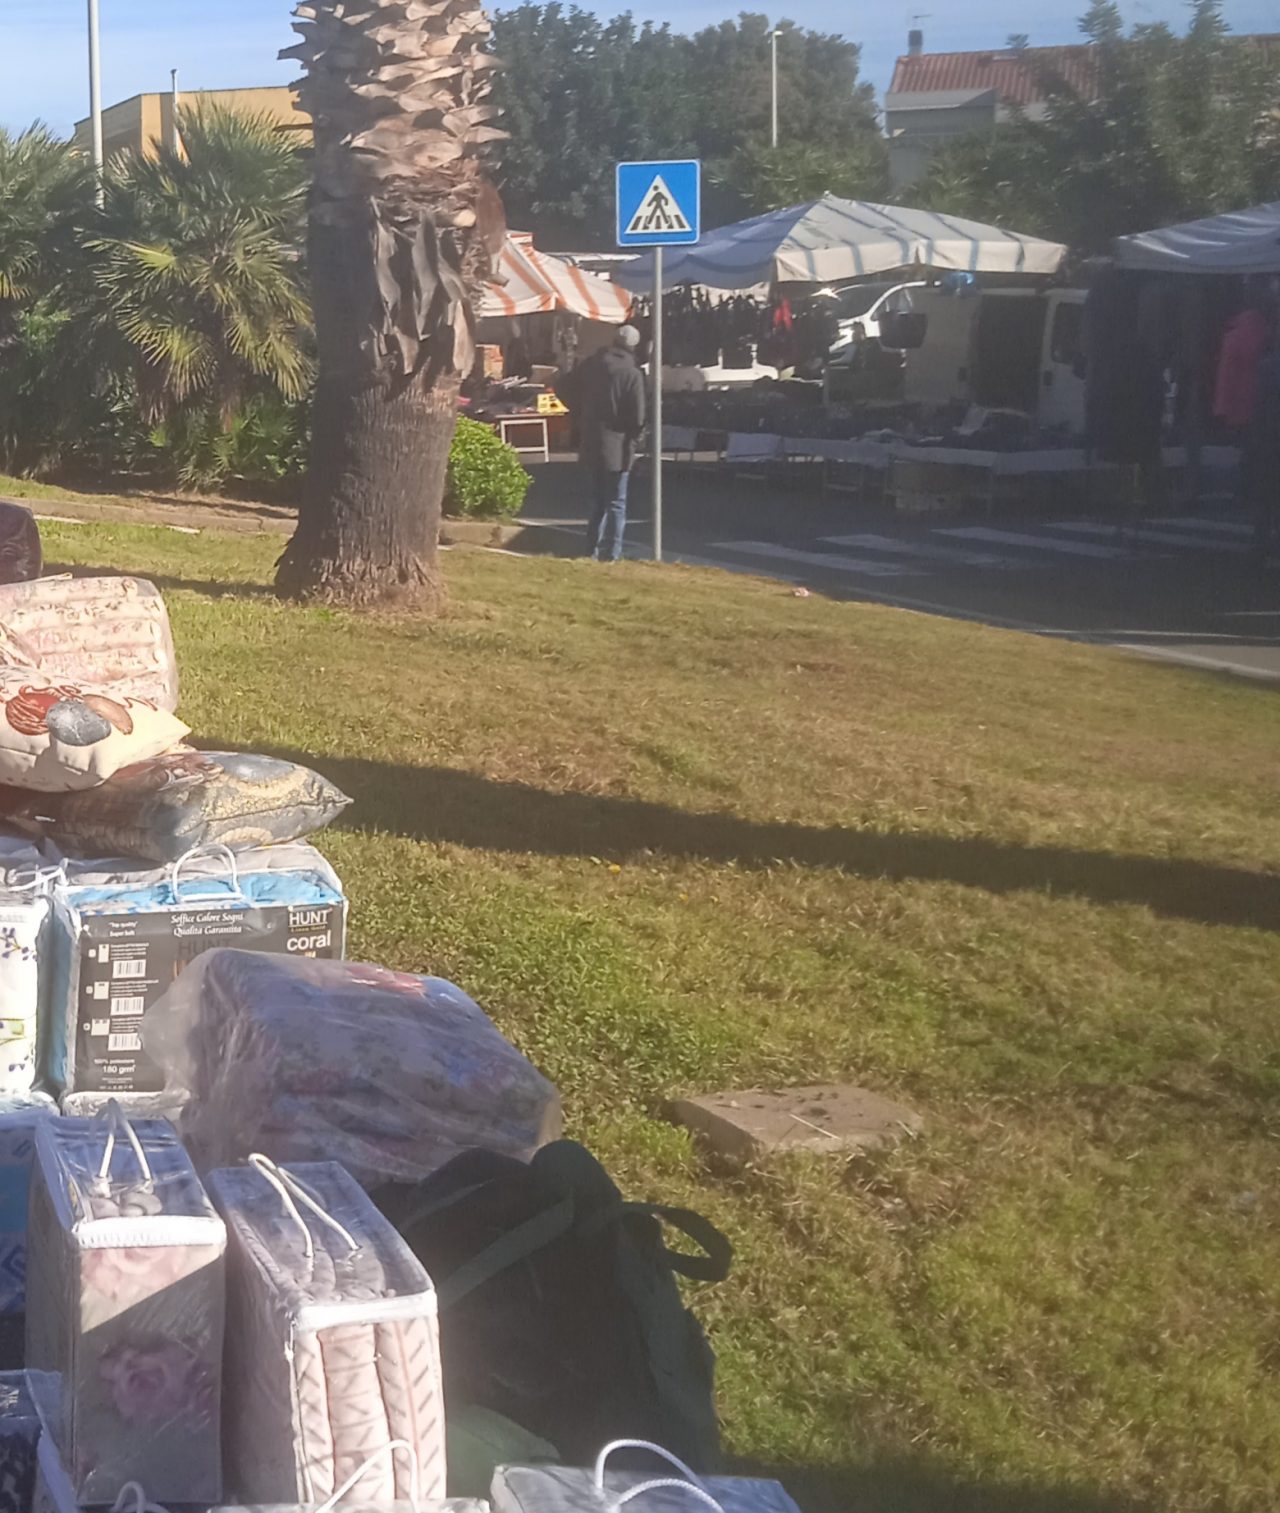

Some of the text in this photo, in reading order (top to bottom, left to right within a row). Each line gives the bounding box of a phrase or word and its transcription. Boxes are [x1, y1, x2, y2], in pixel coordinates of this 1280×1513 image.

[196, 912, 221, 922] Calore
[222, 912, 243, 925] Sogni
[289, 910, 328, 925] HUNT
[204, 925, 242, 935] Garantita
[287, 929, 331, 951] coral
